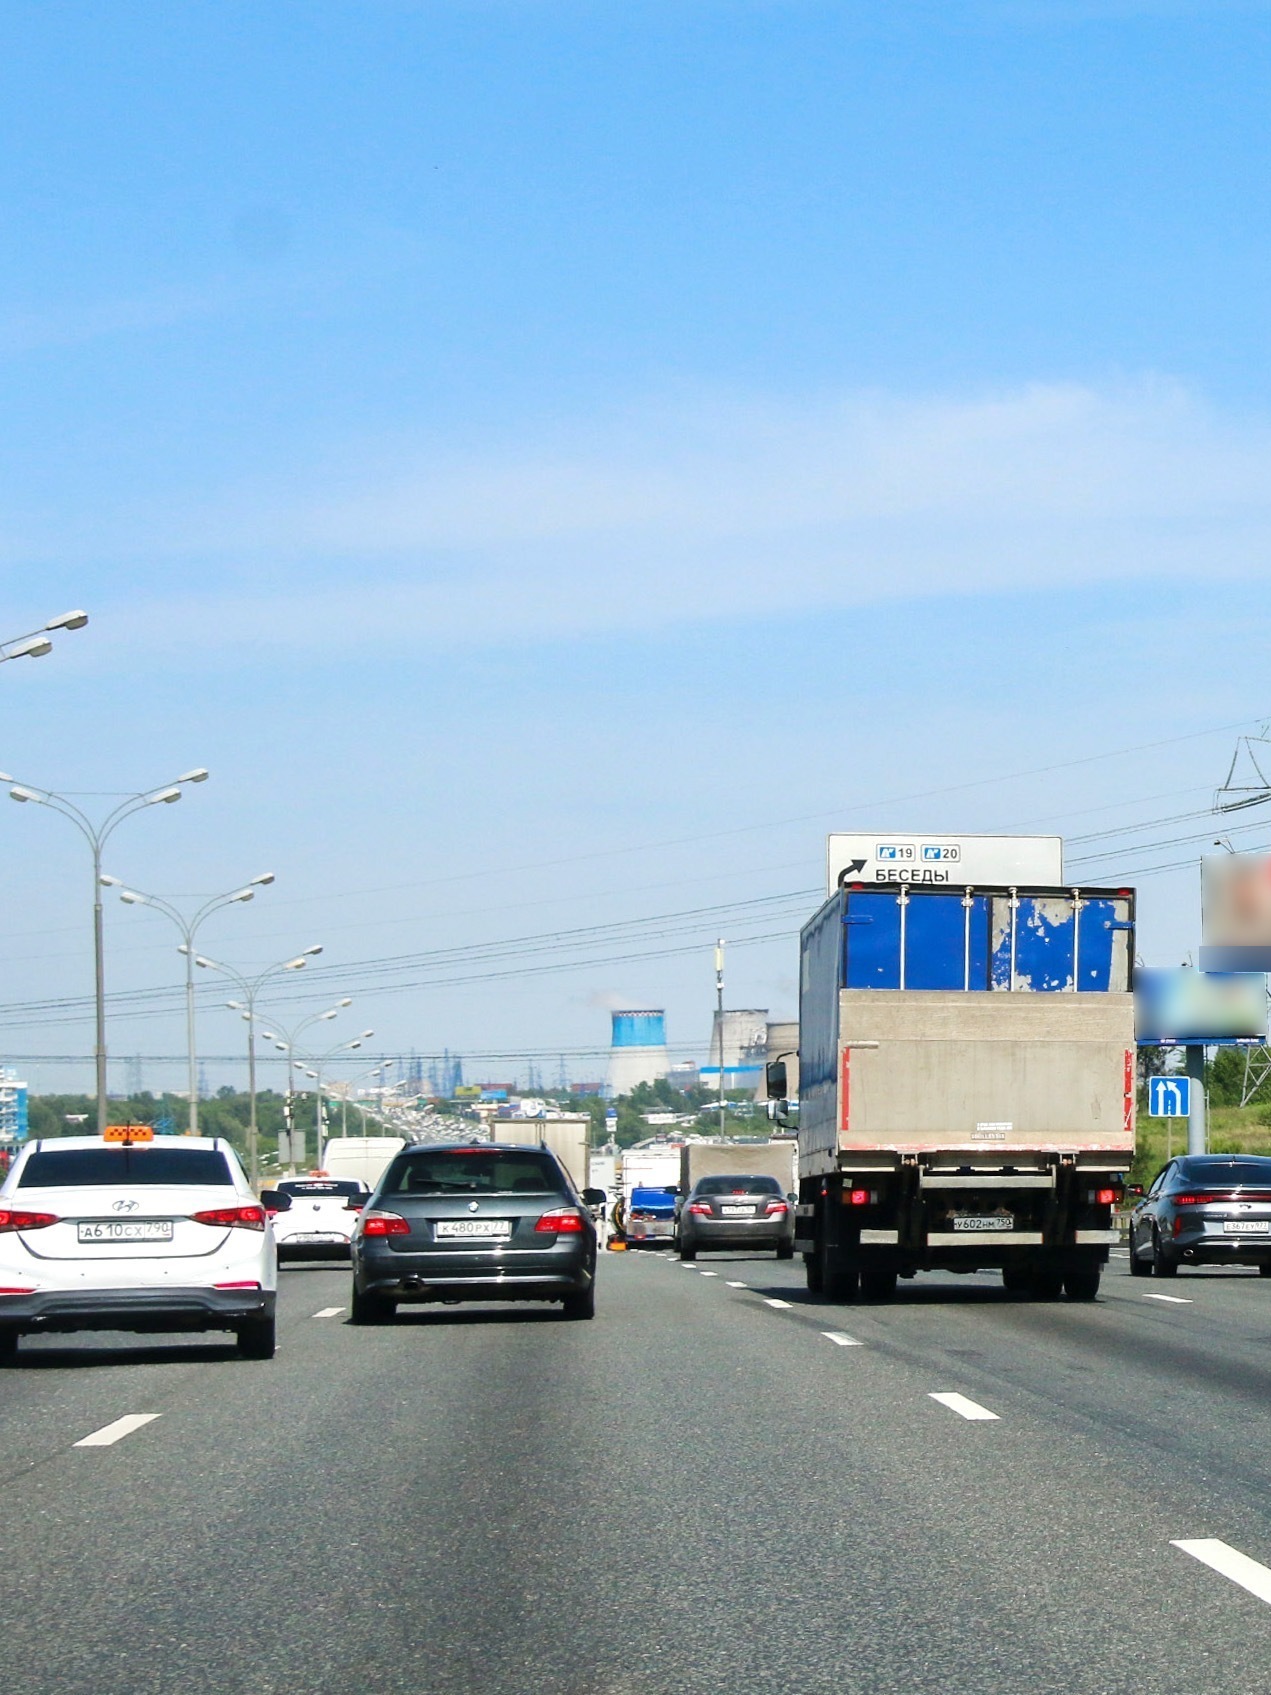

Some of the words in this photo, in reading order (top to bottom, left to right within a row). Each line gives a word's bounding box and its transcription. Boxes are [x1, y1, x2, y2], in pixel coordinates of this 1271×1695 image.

[898, 848, 913, 858] 19
[942, 848, 958, 859] 20
[876, 869, 949, 884] БЕСЕДЫ
